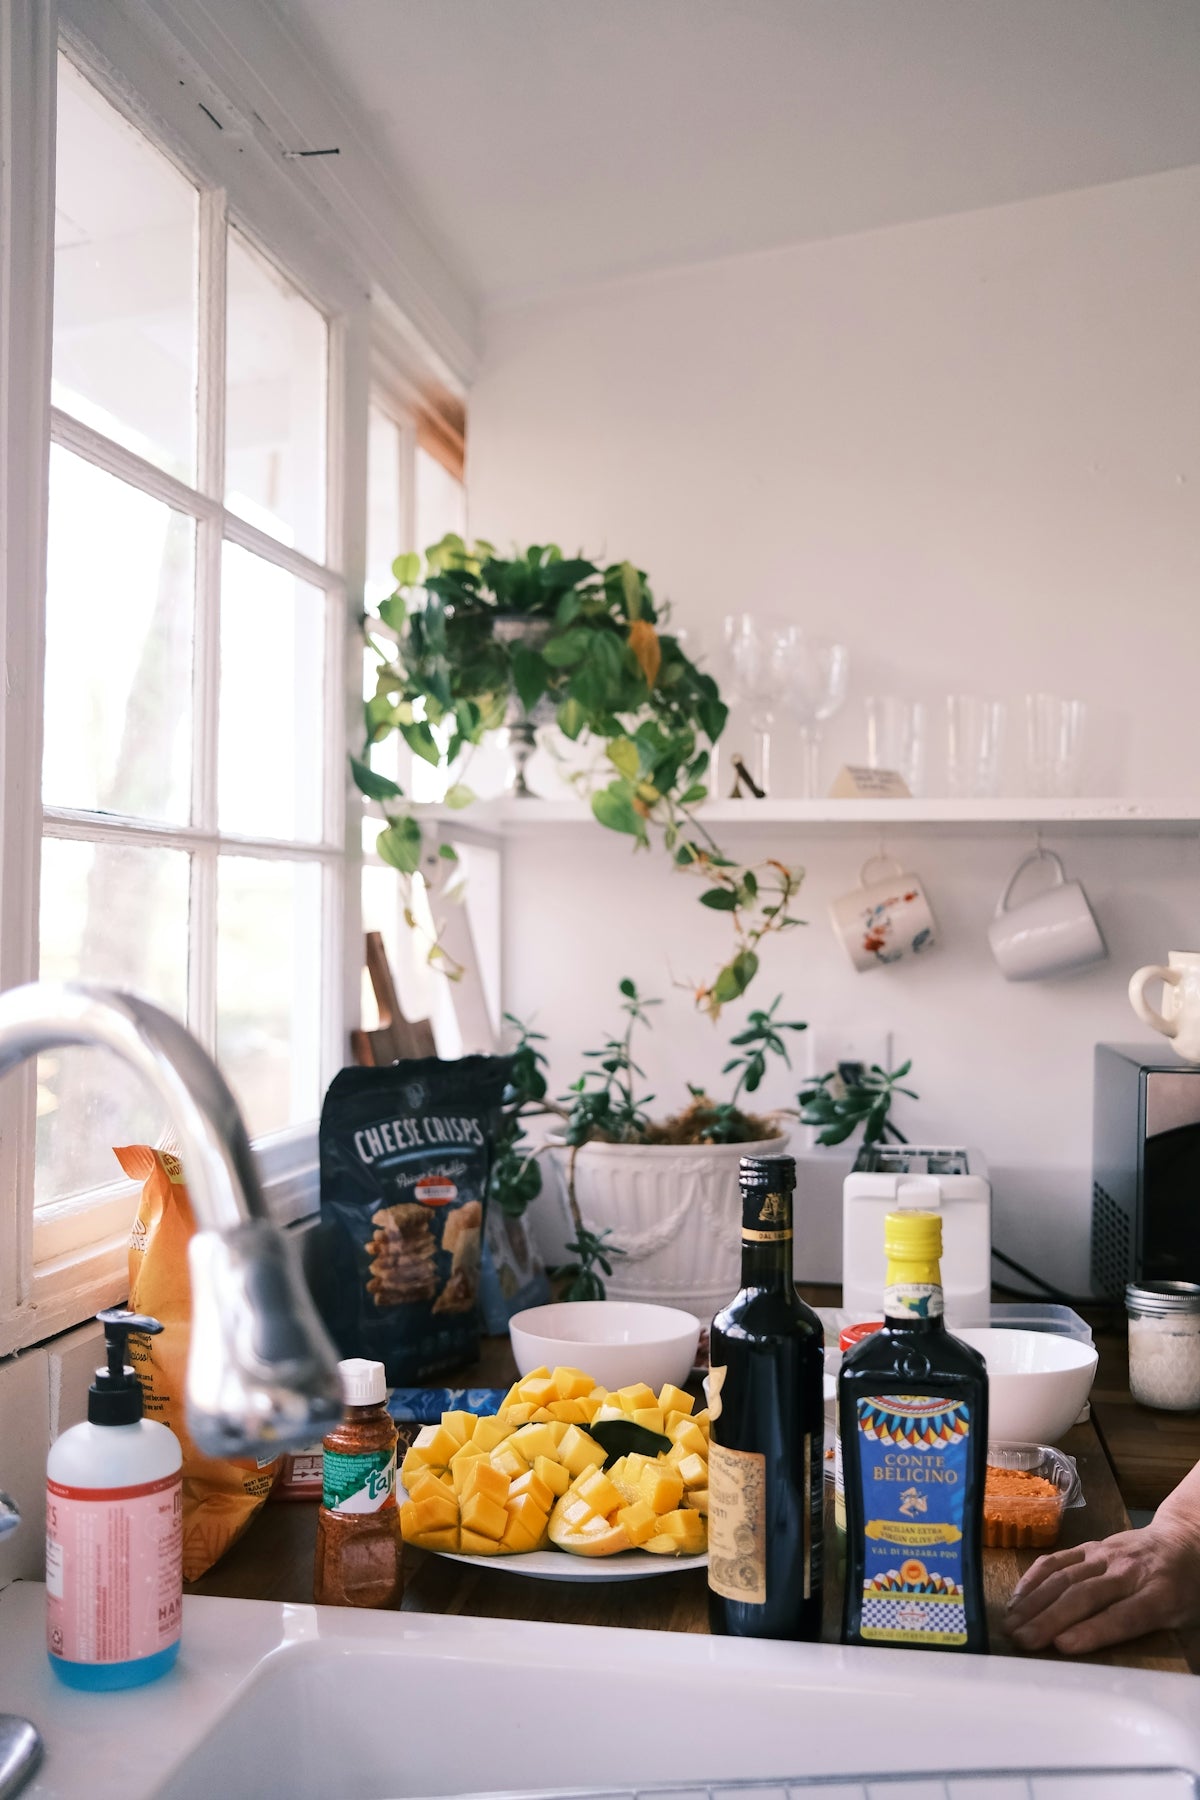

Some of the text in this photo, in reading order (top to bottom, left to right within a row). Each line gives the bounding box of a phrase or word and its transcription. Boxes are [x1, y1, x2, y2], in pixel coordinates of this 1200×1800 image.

[354, 1116, 485, 1164] CHEESE CRISPS
[884, 1453, 945, 1467] CONTE
[873, 1466, 958, 1485] BELICINO
[917, 1526, 942, 1535] EXTRA
